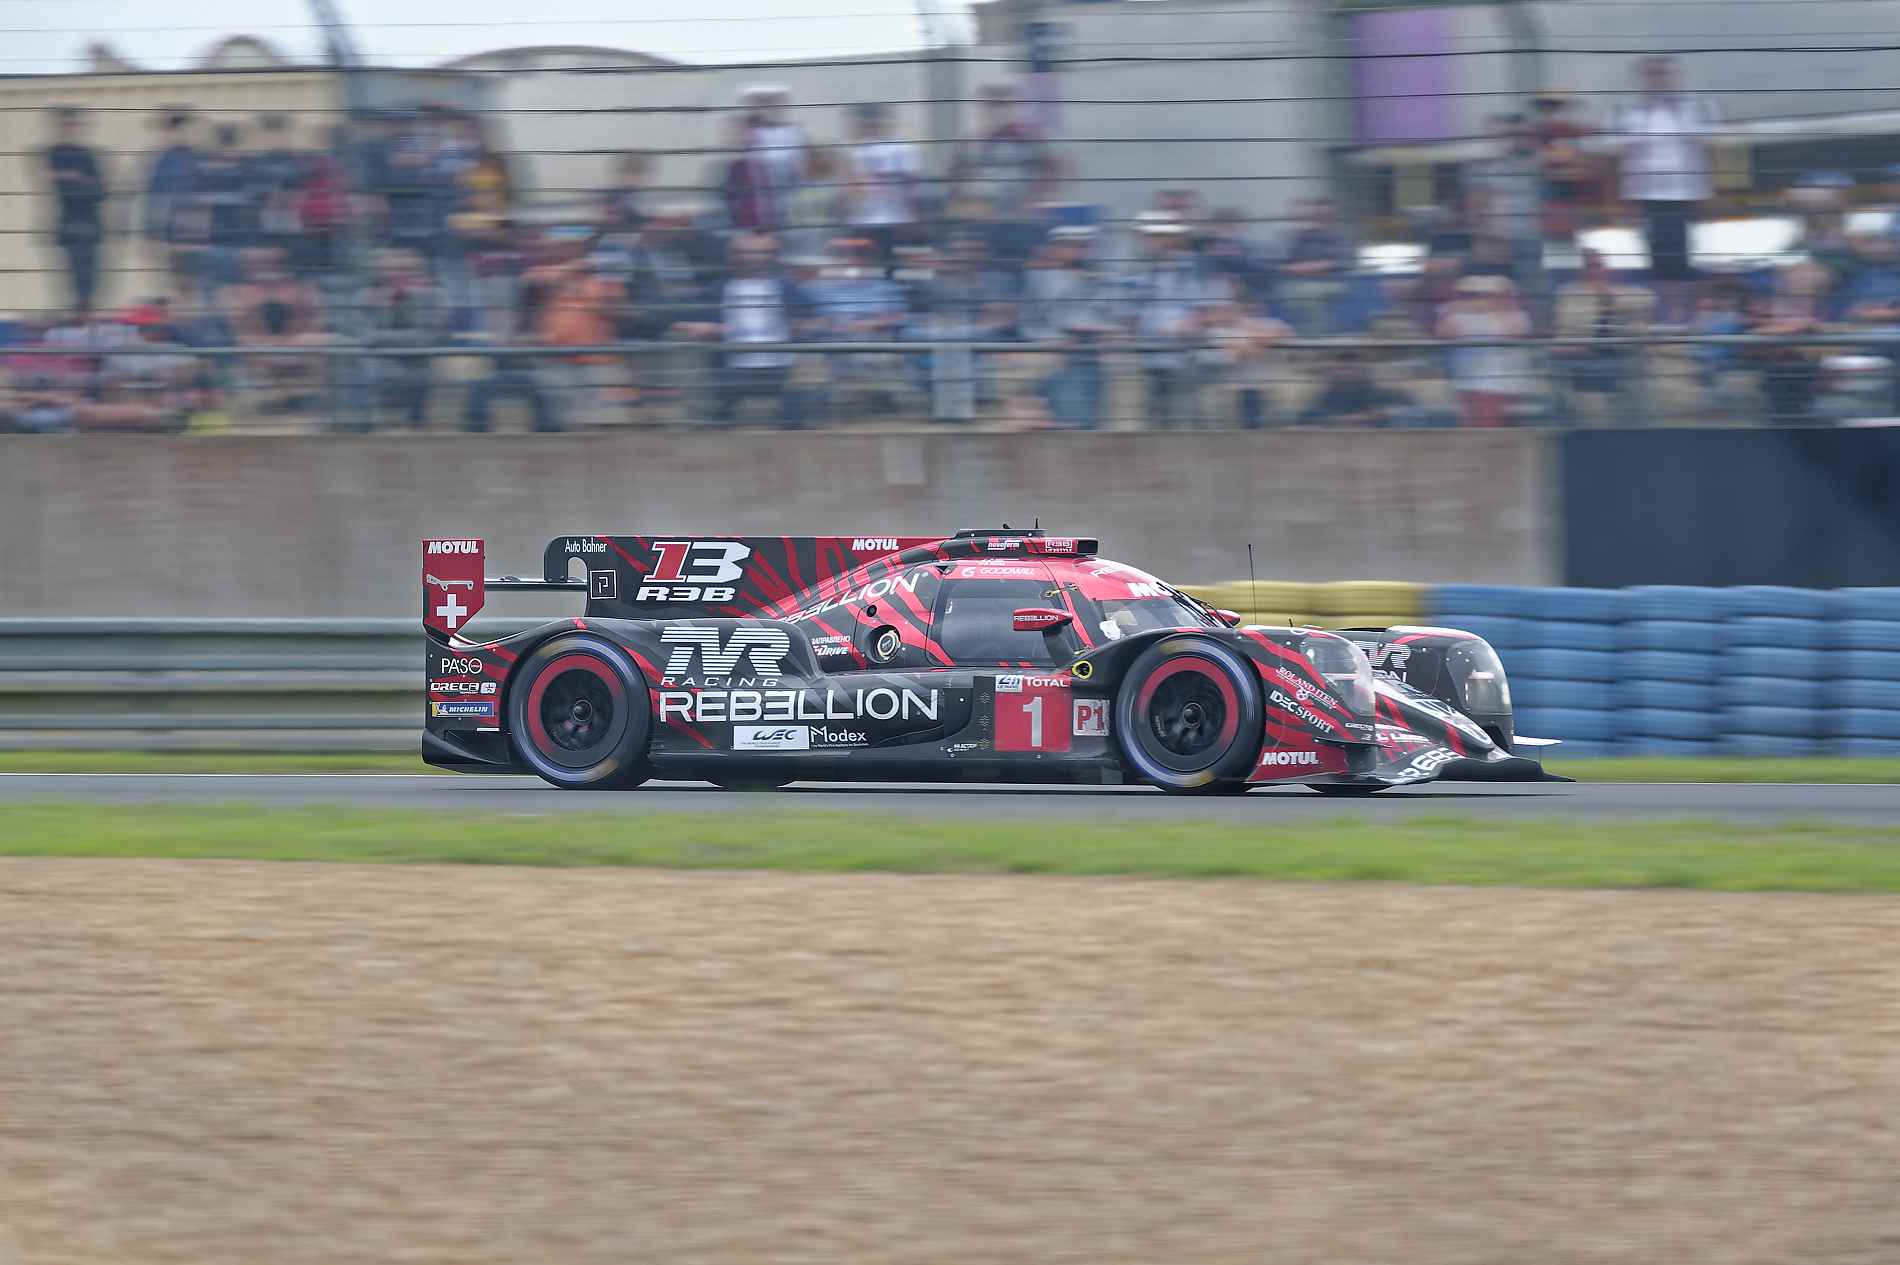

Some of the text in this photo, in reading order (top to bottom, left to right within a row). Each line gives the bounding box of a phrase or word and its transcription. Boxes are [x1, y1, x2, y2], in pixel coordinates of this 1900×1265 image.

[428, 540, 479, 554] MOTUL
[565, 537, 608, 553] Auto Bahner
[852, 538, 899, 551] MOTUL
[1013, 613, 1059, 622] REBELLION
[660, 626, 791, 676] TVR
[430, 682, 480, 692] ORECA
[660, 676, 780, 688] RACING
[1024, 676, 1070, 688] TOTAL
[659, 688, 938, 723] REBELLION
[1022, 696, 1043, 747] 1
[1077, 704, 1104, 731] P1
[752, 729, 798, 741] WEC
[810, 725, 868, 743] Modex
[1262, 751, 1320, 766] MOTUL
